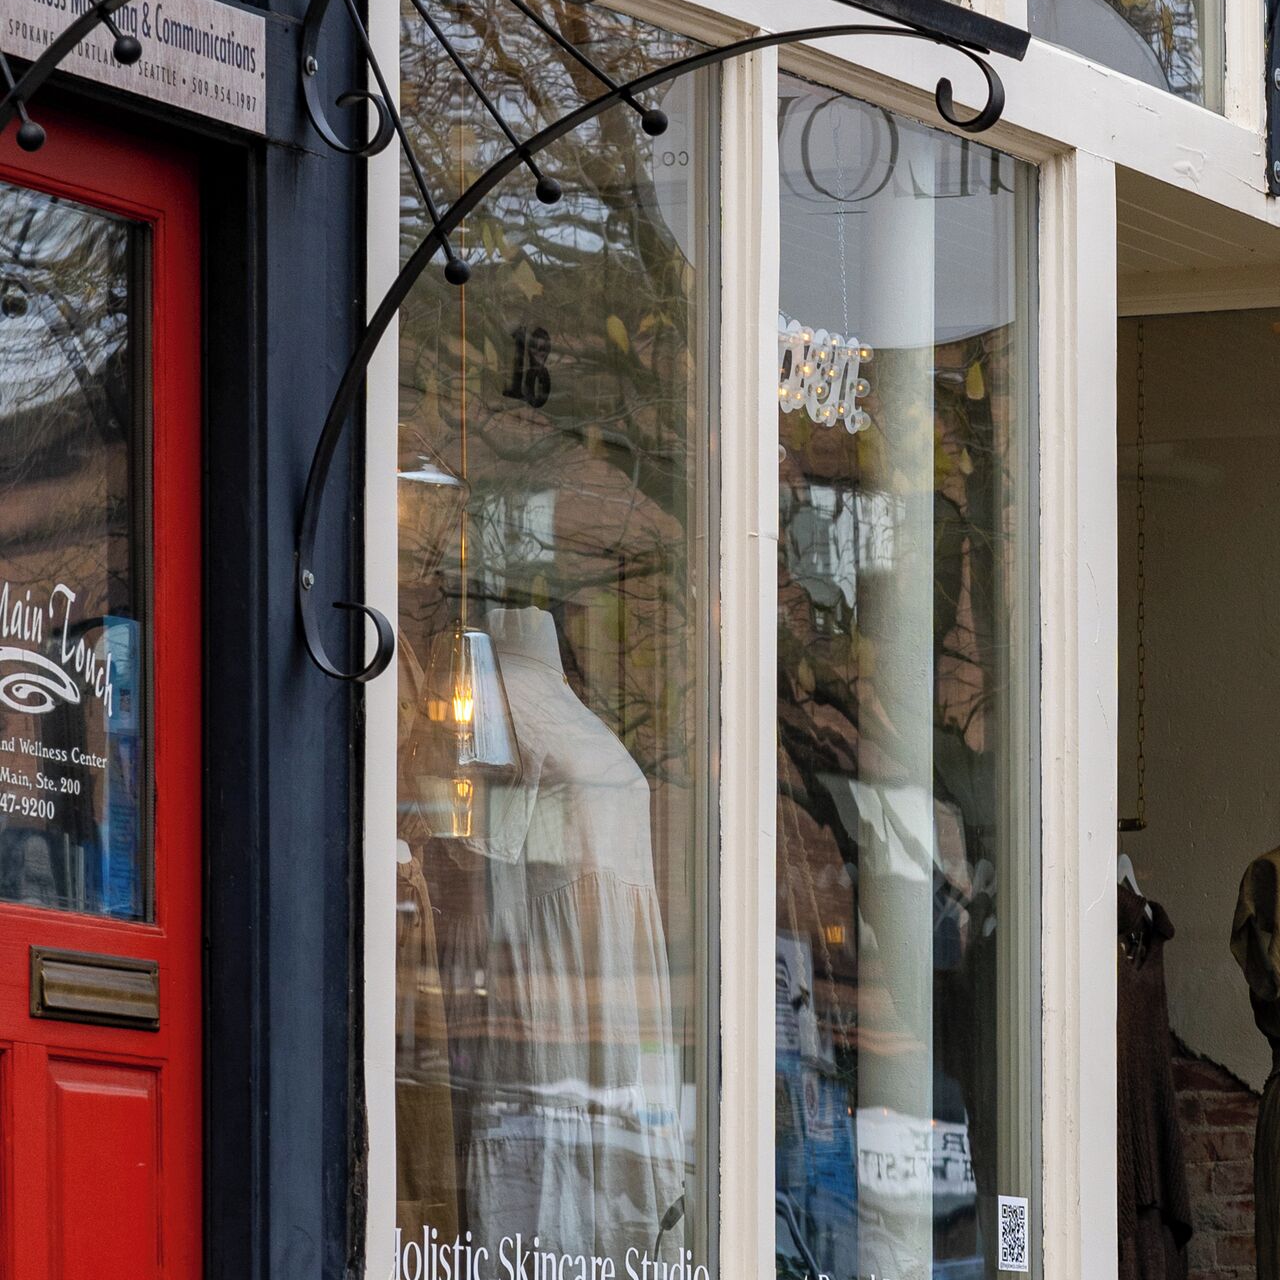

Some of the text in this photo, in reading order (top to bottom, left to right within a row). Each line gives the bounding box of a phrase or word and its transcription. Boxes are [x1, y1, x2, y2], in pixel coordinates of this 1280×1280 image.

[142, 1, 152, 39] &
[155, 3, 256, 74] Communications
[9, 18, 54, 45] SPOKANE
[138, 60, 177, 87] SEATTLE
[192, 77, 257, 112] 509.954.1987
[49, 583, 113, 717] Touch
[0, 737, 108, 768] nd Wellness Center
[0, 793, 55, 819] 47-9200
[36, 772, 57, 792] Ste.
[60, 777, 81, 795] 200
